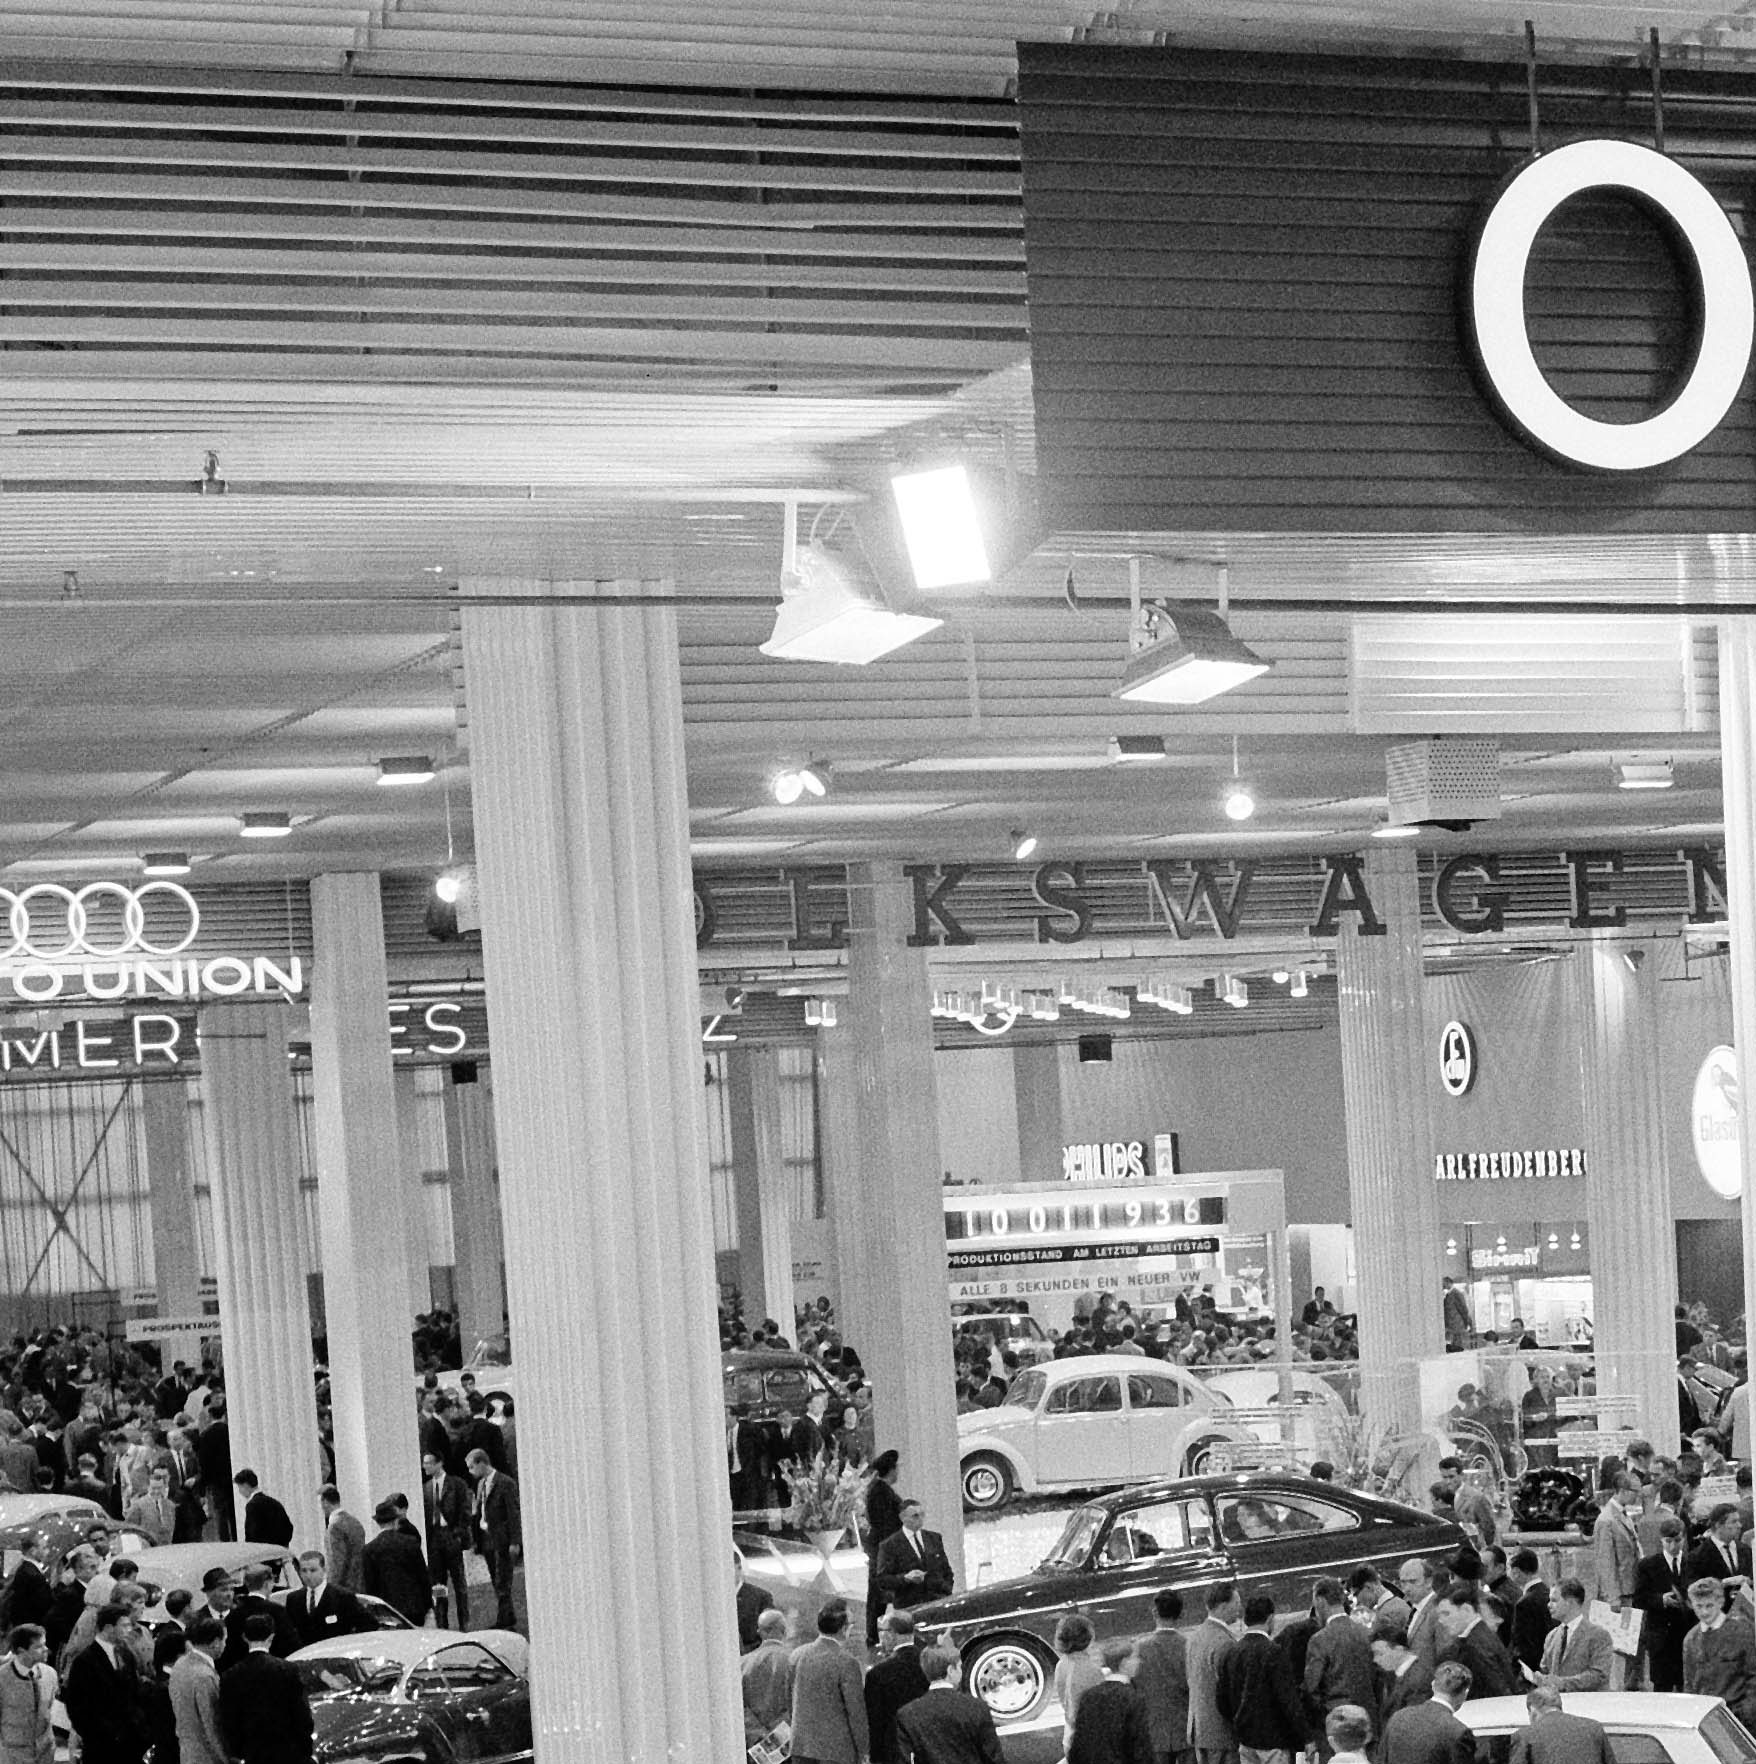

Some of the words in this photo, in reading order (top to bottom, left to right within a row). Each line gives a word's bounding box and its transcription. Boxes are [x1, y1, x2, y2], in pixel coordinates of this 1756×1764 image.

[82, 957, 303, 999] UNION
[1468, 1149, 1587, 1179] FREUDENBER
[960, 1283, 991, 1297] ALLE
[1016, 1278, 1090, 1293] SEKUNDEN
[1097, 1276, 1119, 1289] EIN
[1127, 1272, 1171, 1287] NEUER
[1180, 1271, 1201, 1283] VW
